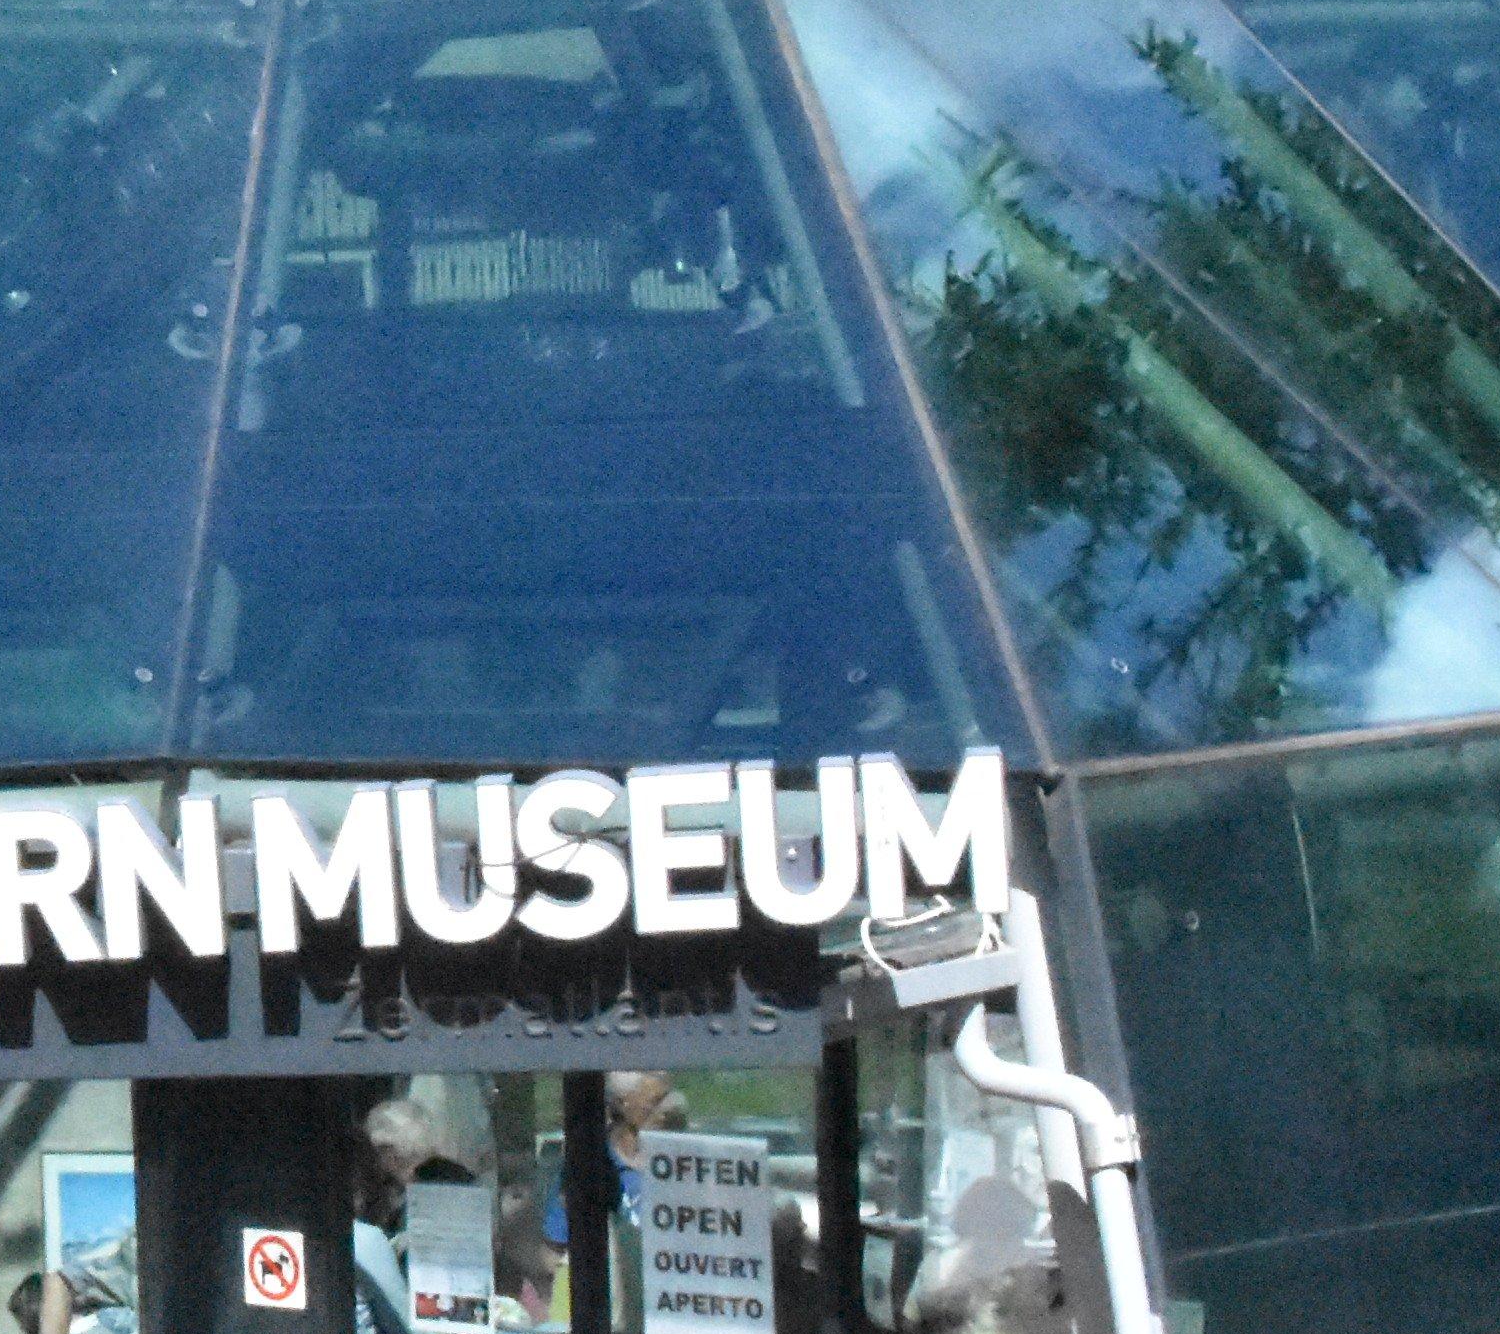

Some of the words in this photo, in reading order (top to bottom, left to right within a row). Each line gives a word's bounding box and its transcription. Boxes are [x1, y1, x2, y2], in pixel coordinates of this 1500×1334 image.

[251, 746, 1012, 956] MUSEUM
[651, 1153, 761, 1187] OFFEN
[652, 1203, 744, 1238] OPEN
[654, 1250, 763, 1280] OUVERT
[656, 1291, 765, 1320] APERTO
